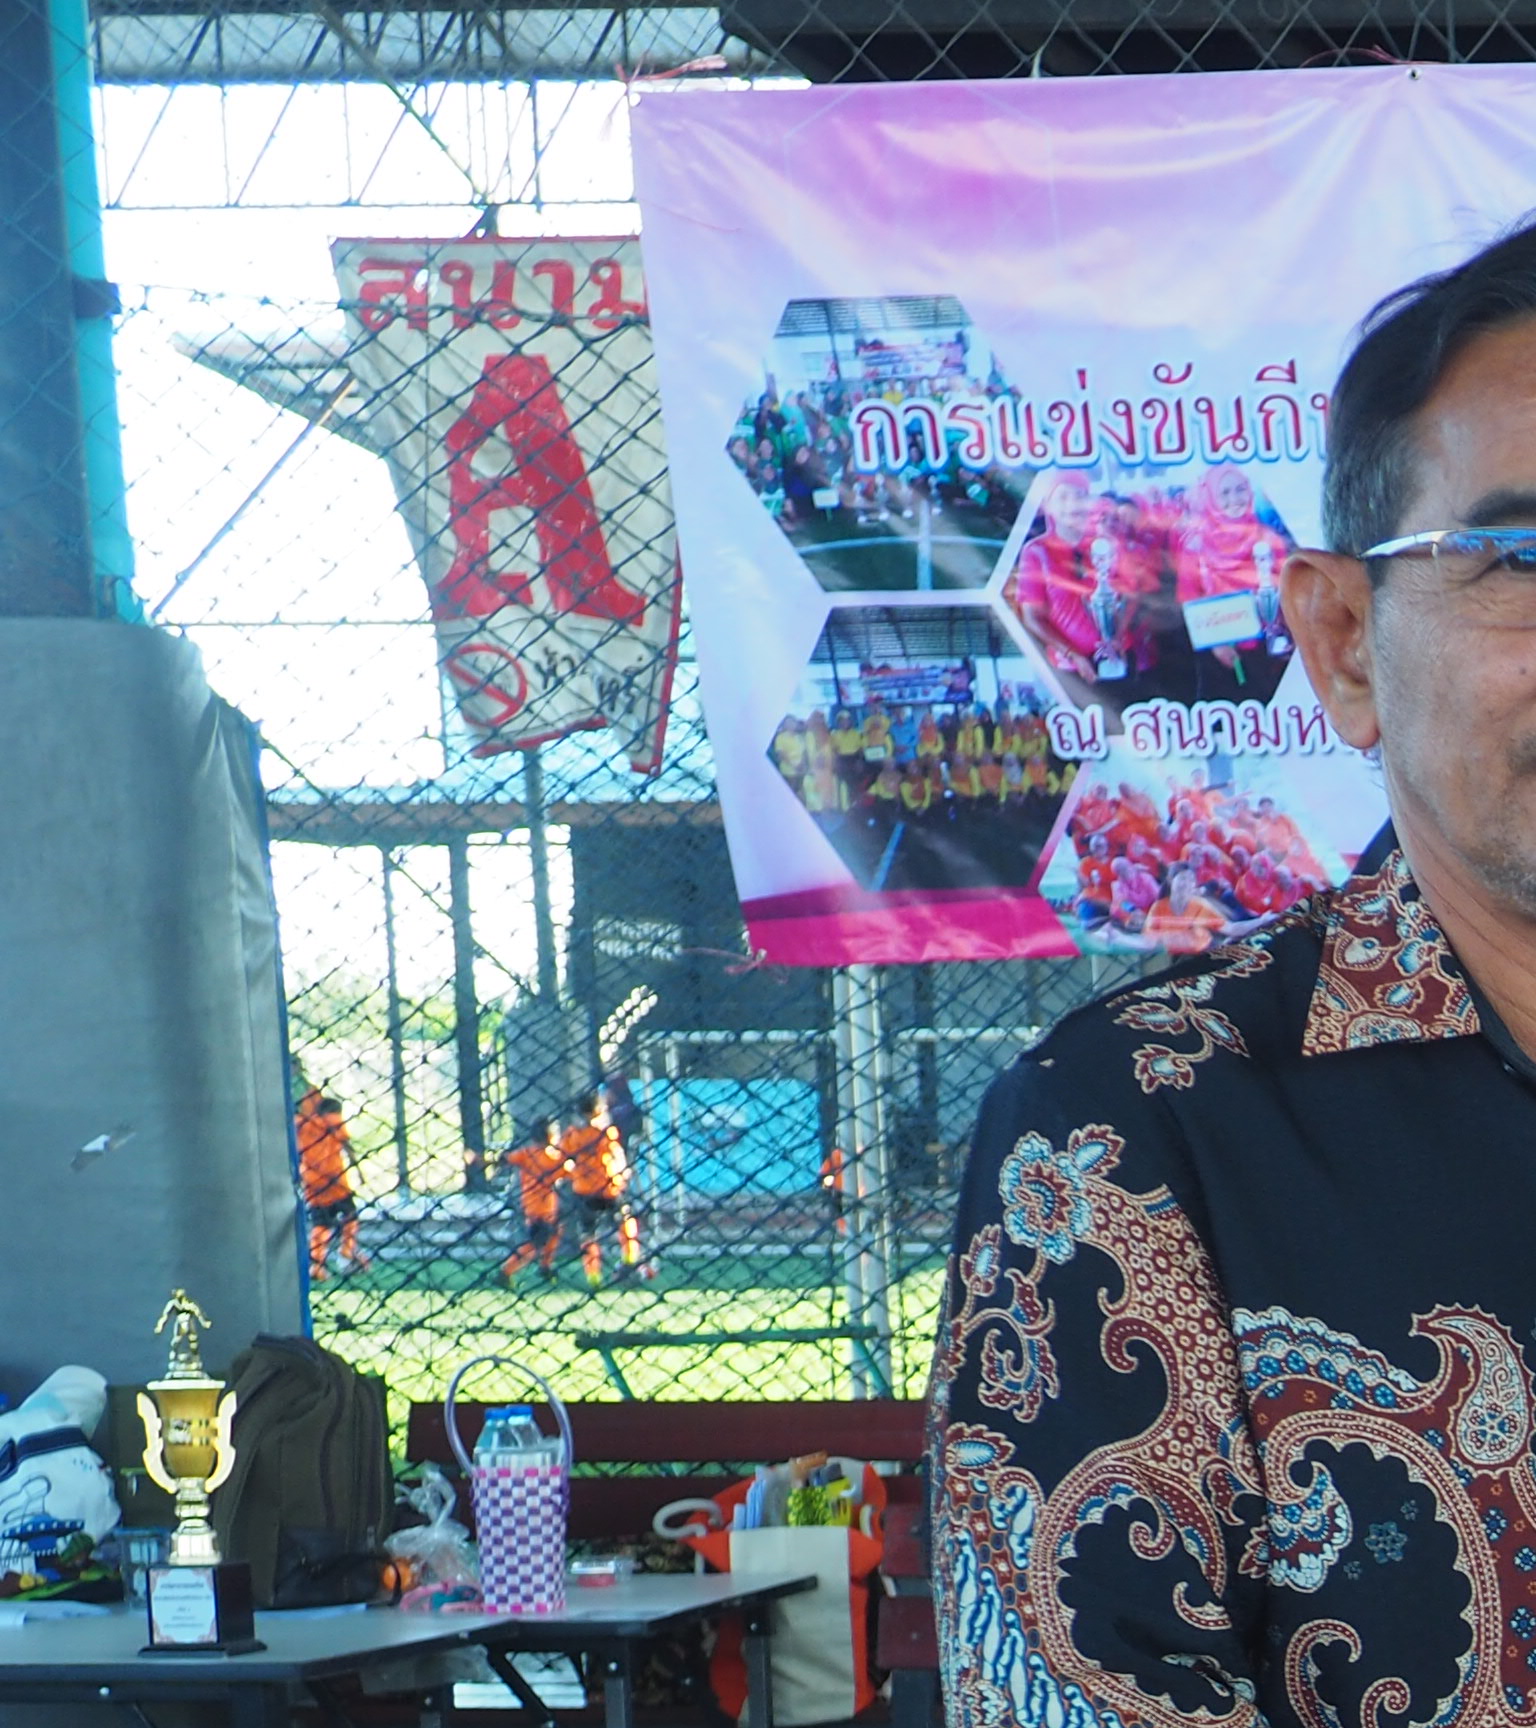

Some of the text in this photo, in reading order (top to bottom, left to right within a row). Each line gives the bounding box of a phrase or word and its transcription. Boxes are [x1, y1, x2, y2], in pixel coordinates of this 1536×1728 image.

[853, 358, 1331, 466] การแข่งขันกี
[431, 354, 646, 626] A
[1127, 702, 1332, 753] สนามห
